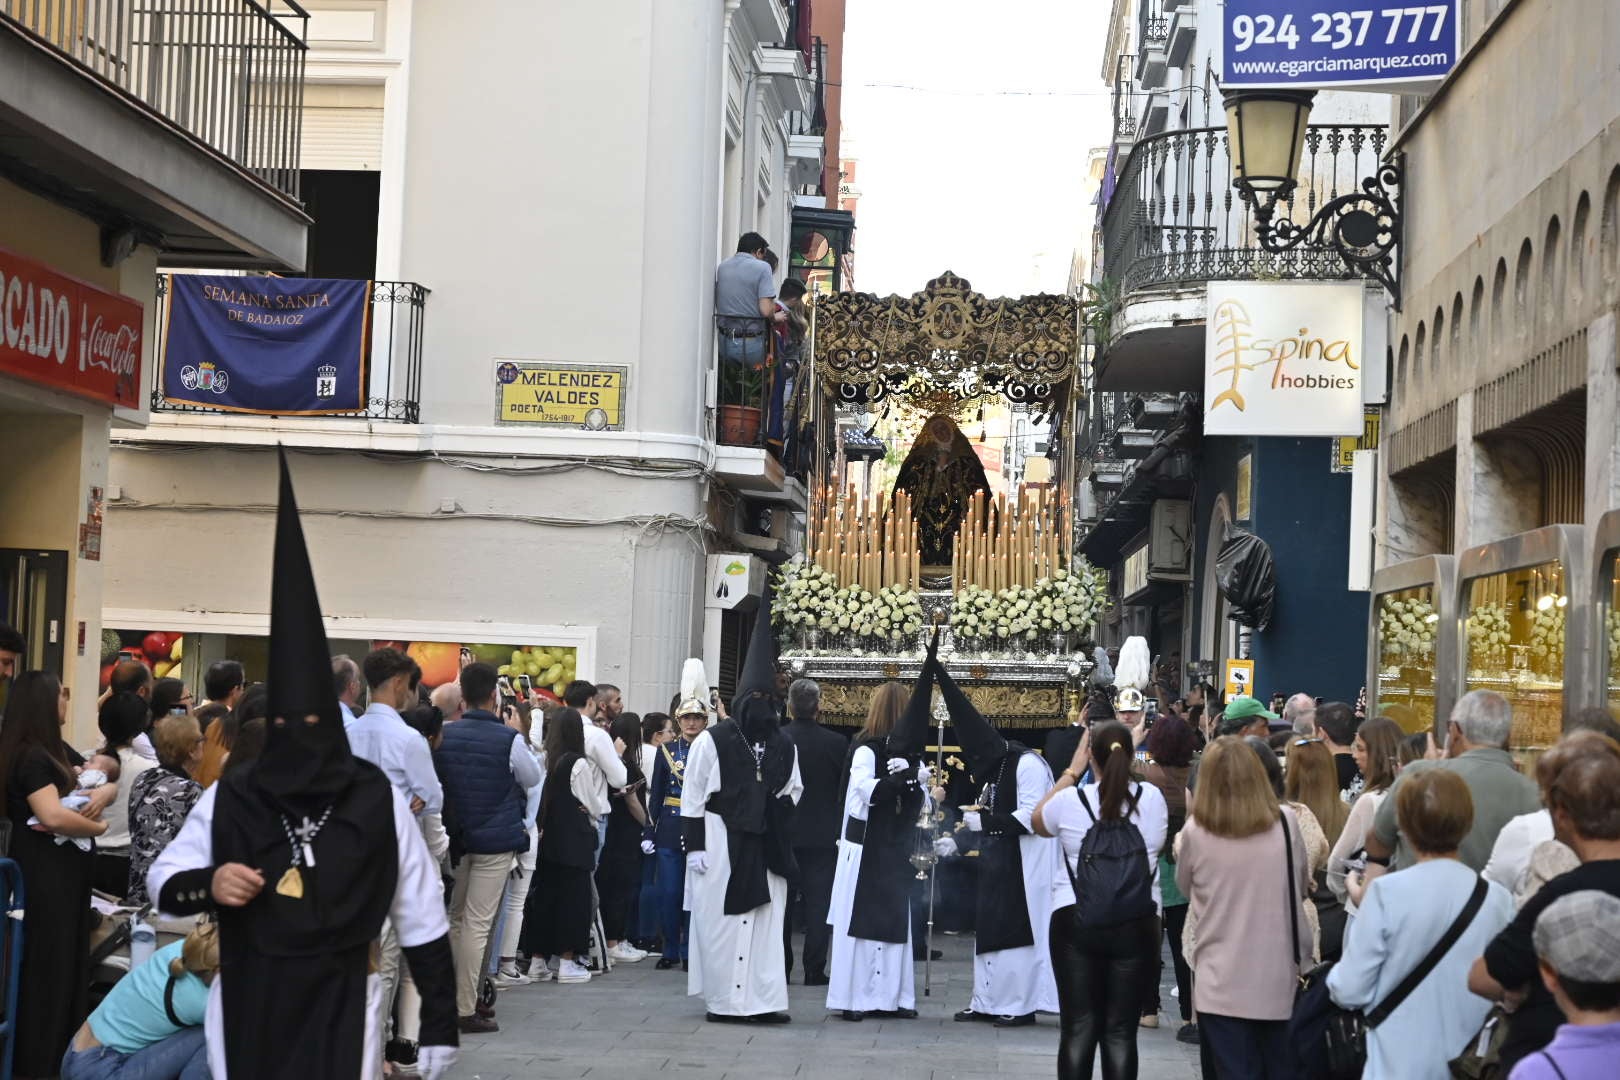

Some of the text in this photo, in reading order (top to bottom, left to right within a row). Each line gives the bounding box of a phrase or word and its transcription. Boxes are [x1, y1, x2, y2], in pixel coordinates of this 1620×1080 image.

[1232, 5, 1449, 52] 924 237 777
[1232, 52, 1448, 77] www.egarciamarquez.com
[203, 284, 330, 310] SEMANA SANTA
[228, 309, 245, 321] DE
[521, 372, 613, 388] MELENDEZ
[1280, 374, 1355, 390] hobbies
[534, 390, 600, 406] VALDES
[510, 404, 544, 414] POETA
[541, 414, 576, 422] 1754-1817
